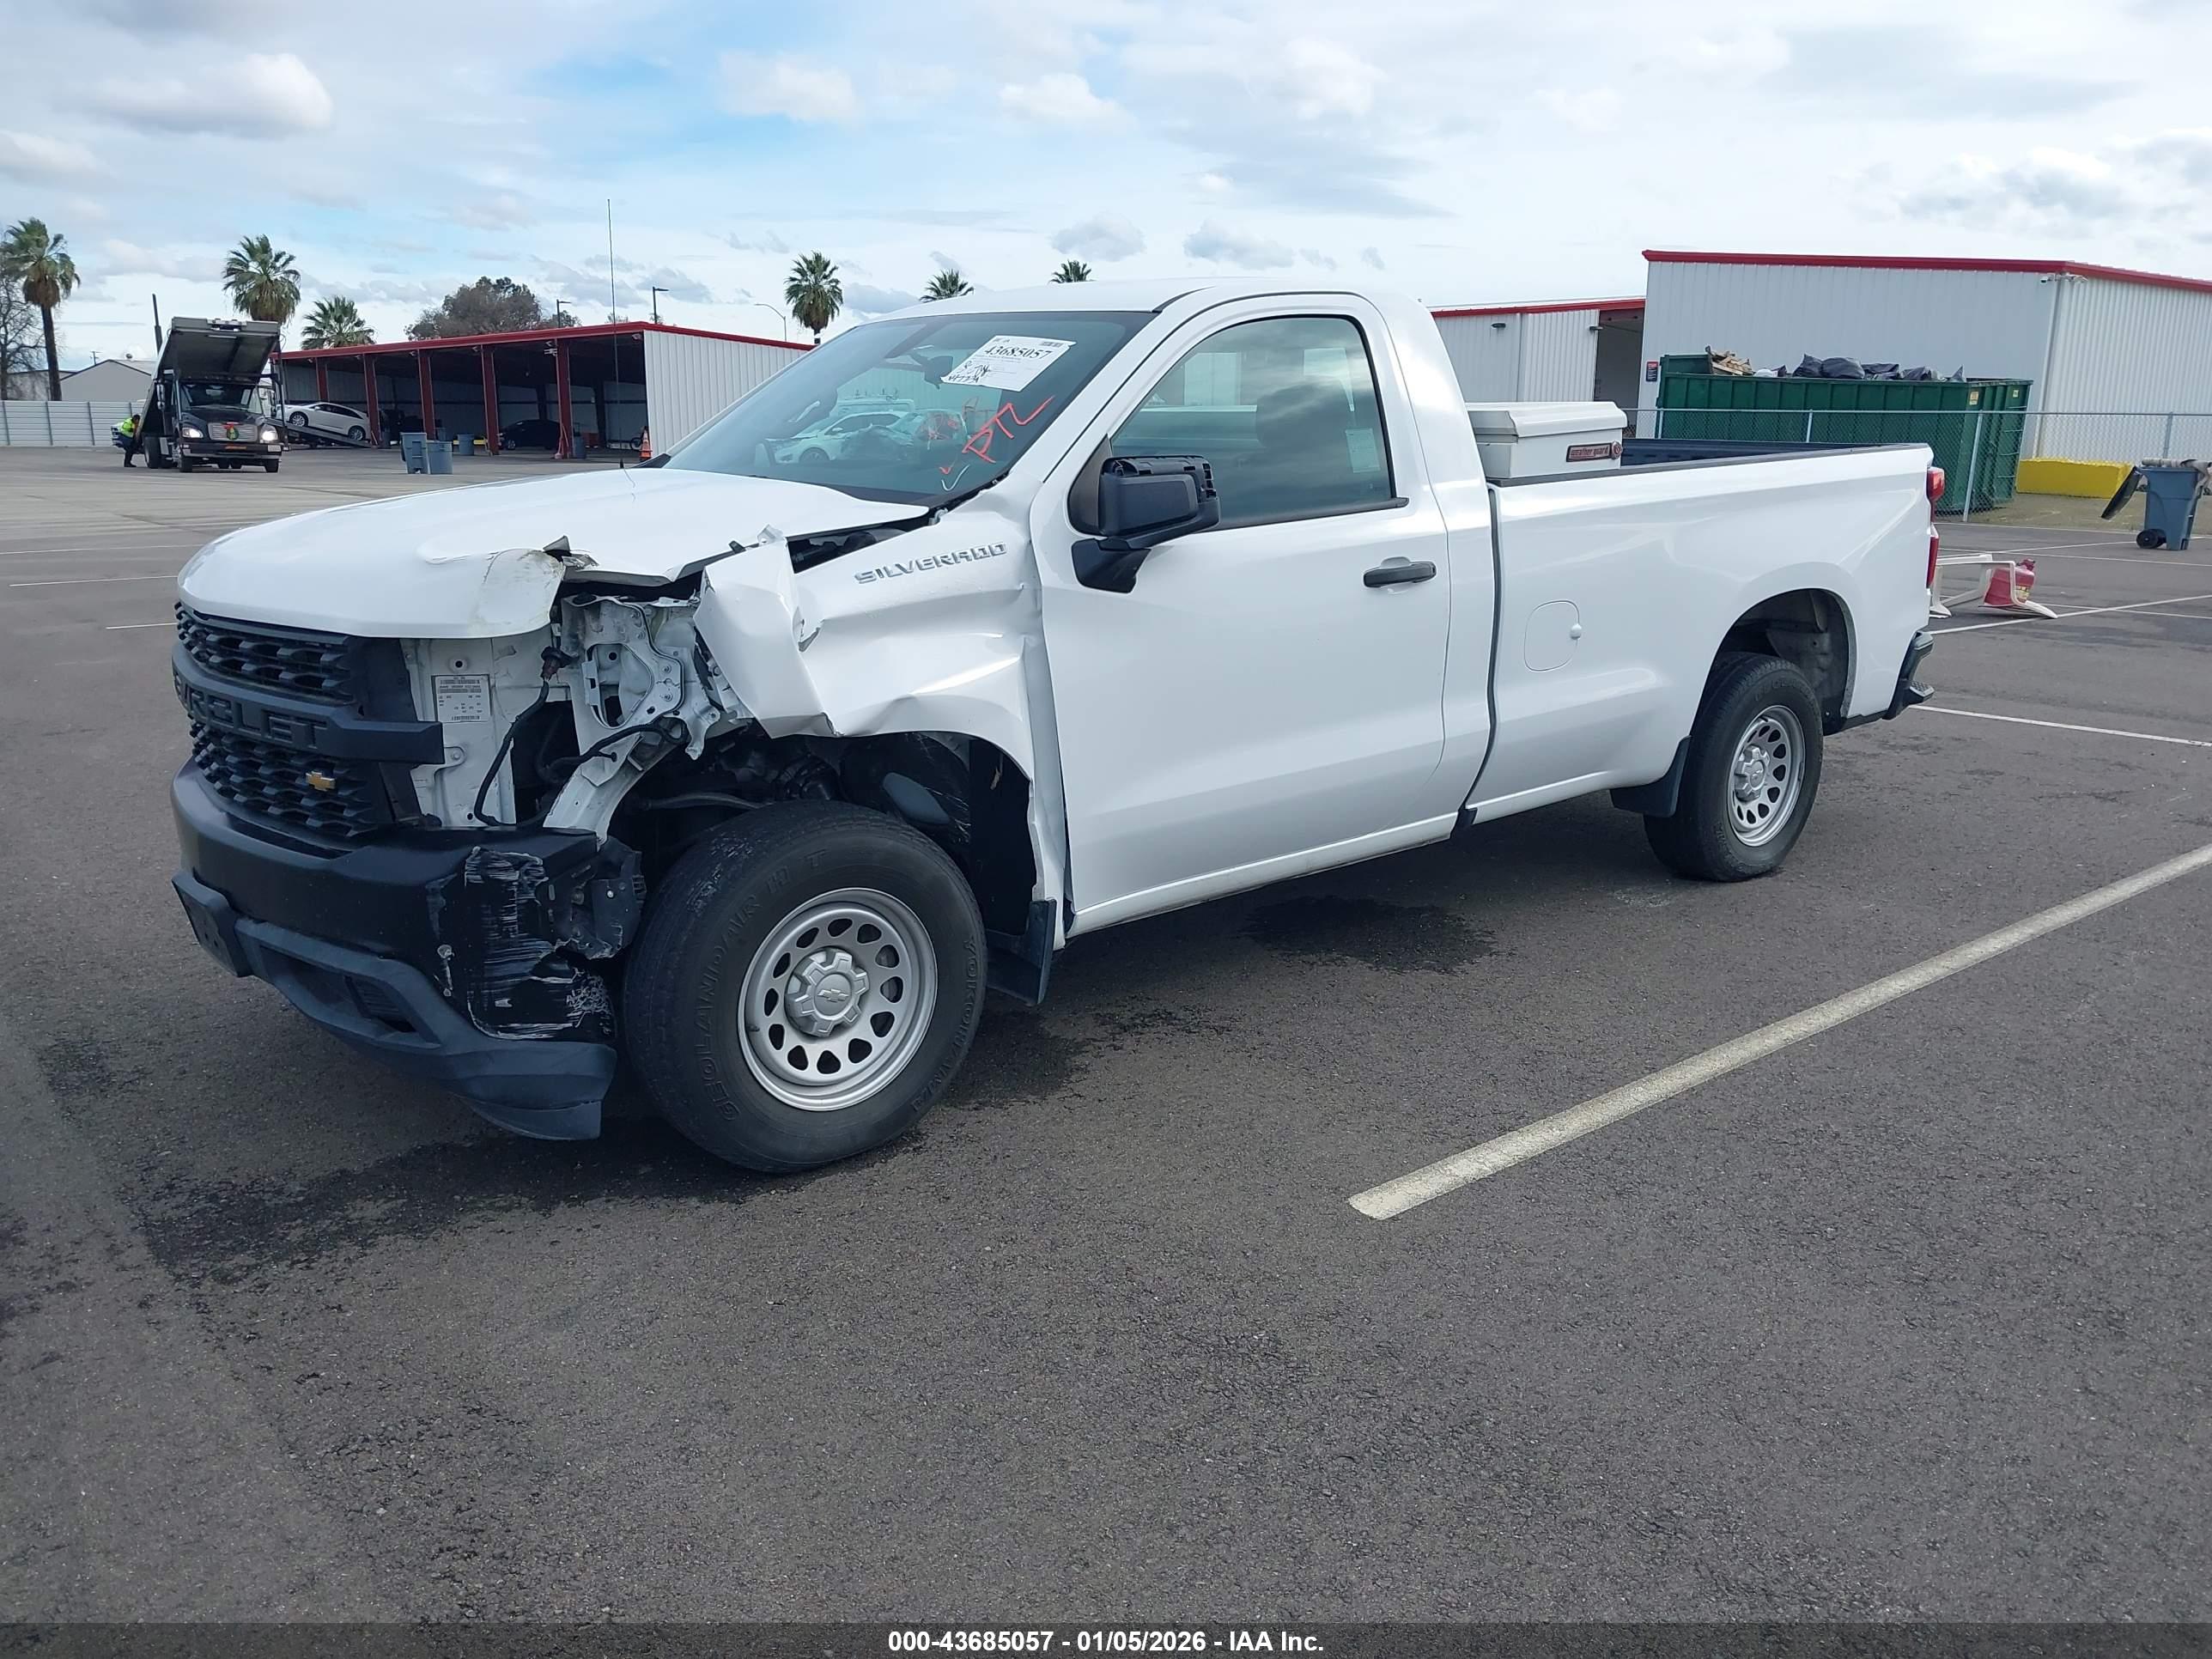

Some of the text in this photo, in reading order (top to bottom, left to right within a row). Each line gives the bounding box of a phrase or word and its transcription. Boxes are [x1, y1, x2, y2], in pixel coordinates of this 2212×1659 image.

[984, 344, 1053, 359] 43685057
[854, 542, 1007, 584] SILVERADO
[910, 935, 977, 1112] YOKOHAMA
